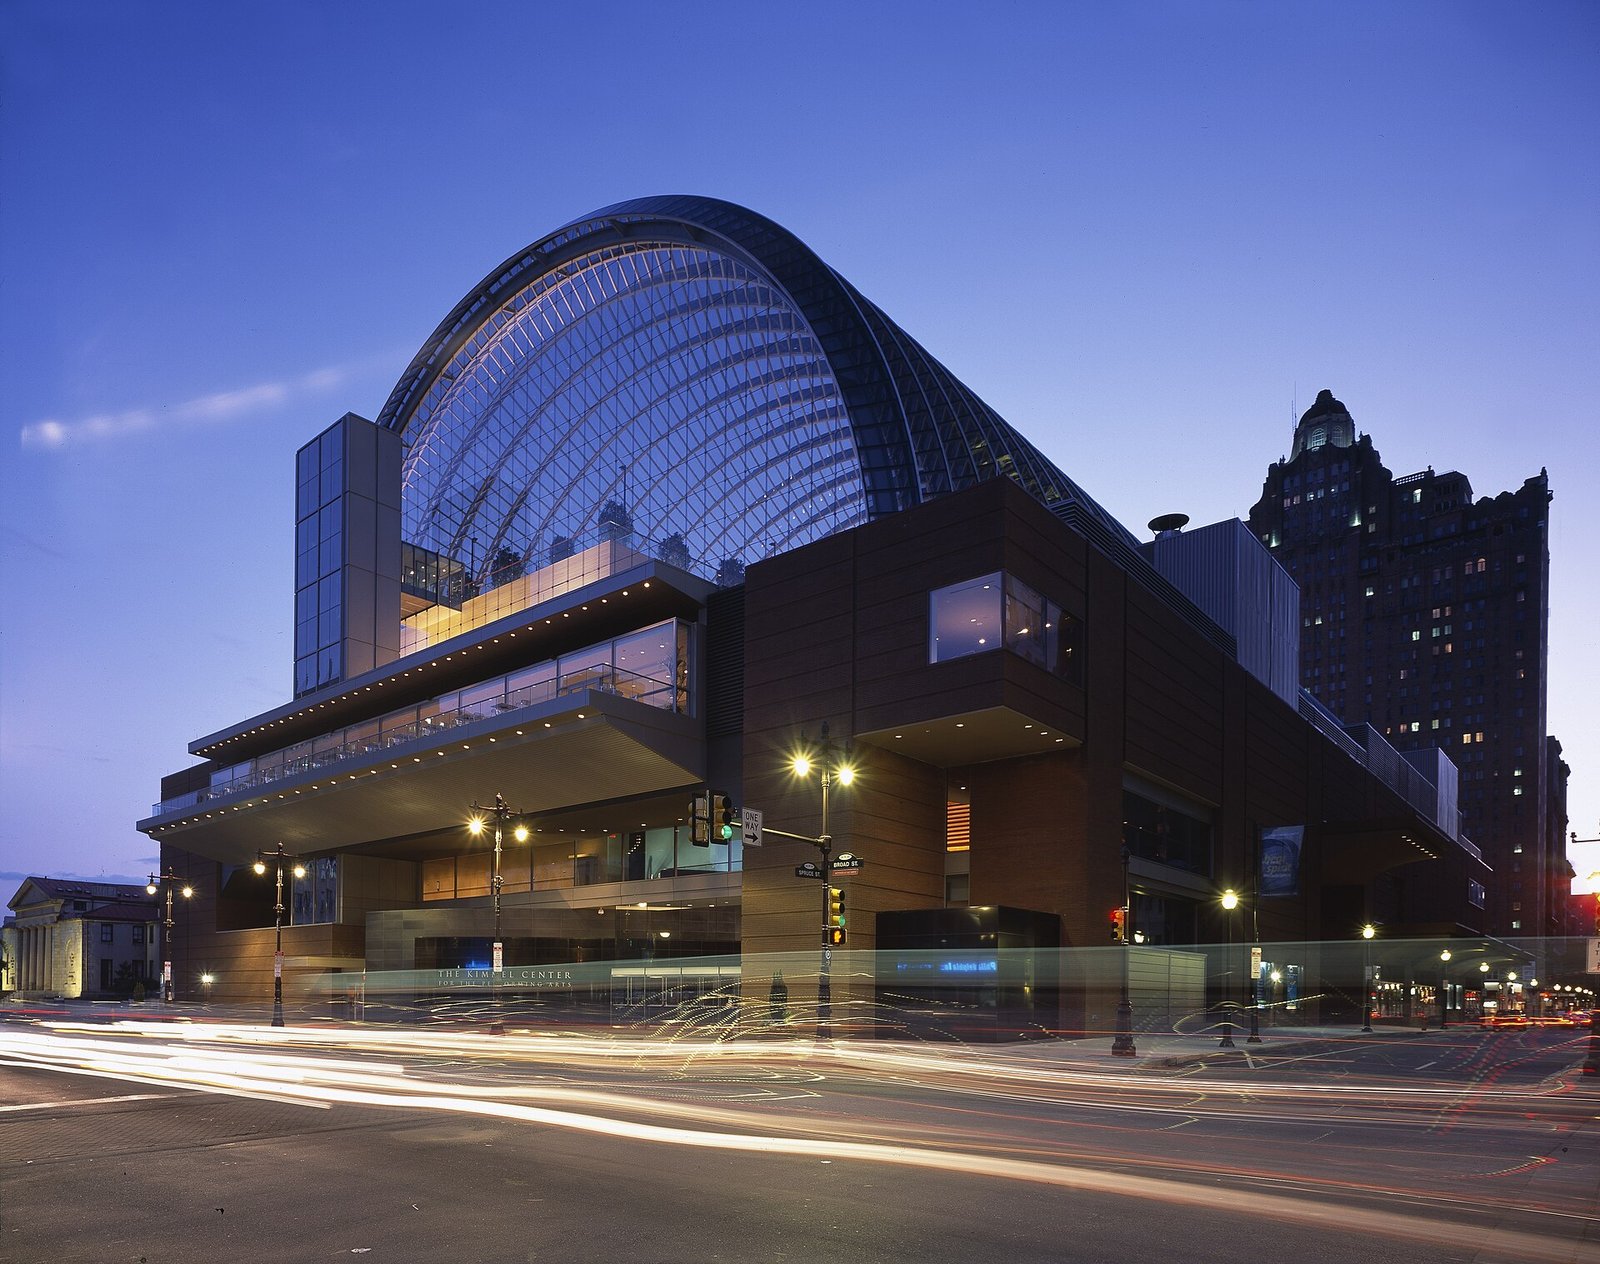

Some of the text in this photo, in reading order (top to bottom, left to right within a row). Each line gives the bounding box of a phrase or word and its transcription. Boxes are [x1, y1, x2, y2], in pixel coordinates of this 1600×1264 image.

[745, 812, 759, 822] ONE
[745, 822, 759, 831] WAY
[438, 970, 460, 978] THE
[521, 970, 571, 979] CENTER
